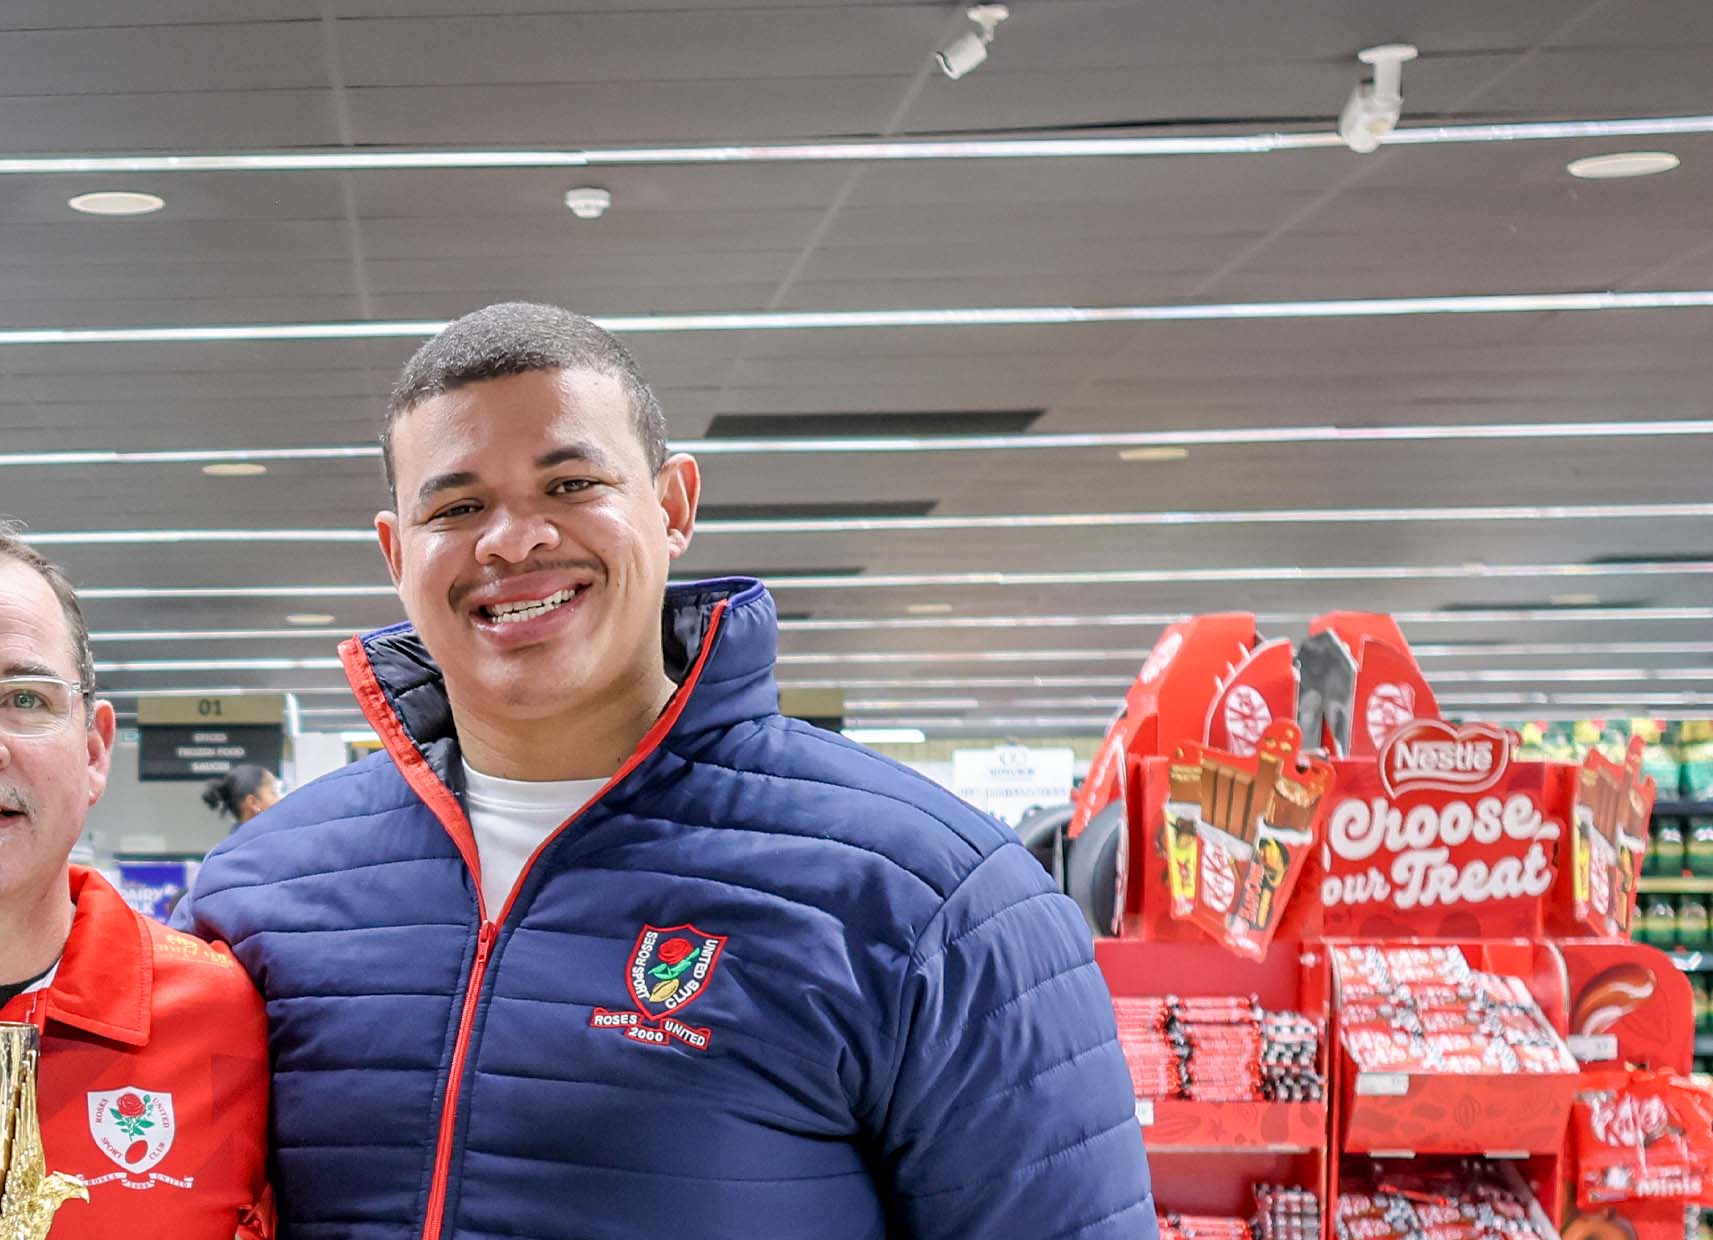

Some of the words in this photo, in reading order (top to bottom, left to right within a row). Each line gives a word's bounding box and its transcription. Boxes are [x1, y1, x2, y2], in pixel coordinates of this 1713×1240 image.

[198, 699, 222, 716] 01
[1394, 740, 1494, 772] Nestlé
[1329, 793, 1561, 861] Choose
[1321, 856, 1391, 908] our
[1391, 842, 1553, 910] Treat
[636, 931, 658, 967] ROSES
[692, 938, 719, 980] UNITED
[664, 979, 700, 1009] CLUB
[593, 1014, 638, 1025] ROSES
[628, 1026, 664, 1043] 2000
[664, 1020, 706, 1047] UNITED
